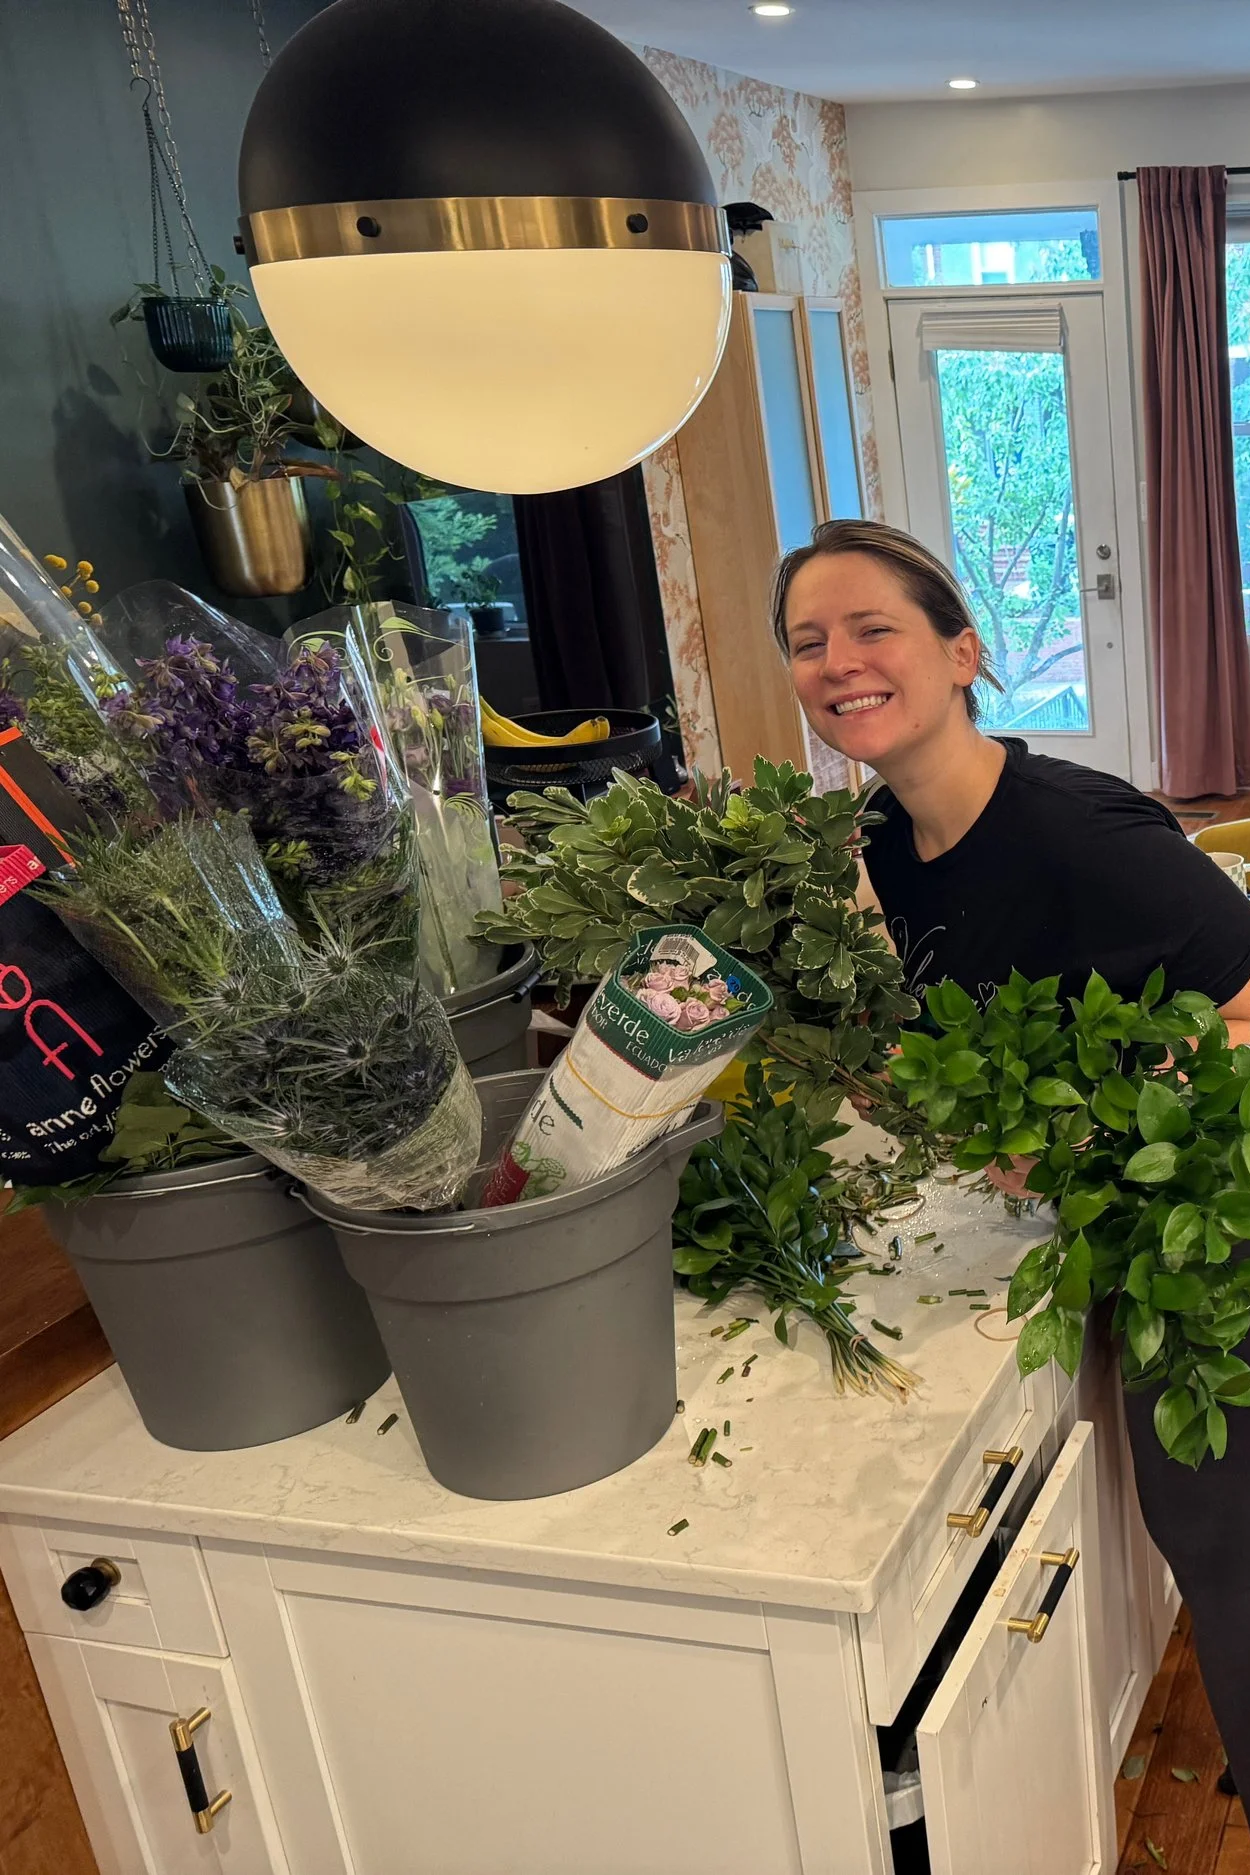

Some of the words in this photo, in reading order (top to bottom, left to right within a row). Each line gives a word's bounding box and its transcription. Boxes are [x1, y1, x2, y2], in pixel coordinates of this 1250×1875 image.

[26, 1096, 97, 1137] anne
[90, 1025, 167, 1098] flowers
[626, 1041, 670, 1074] ECUADO
